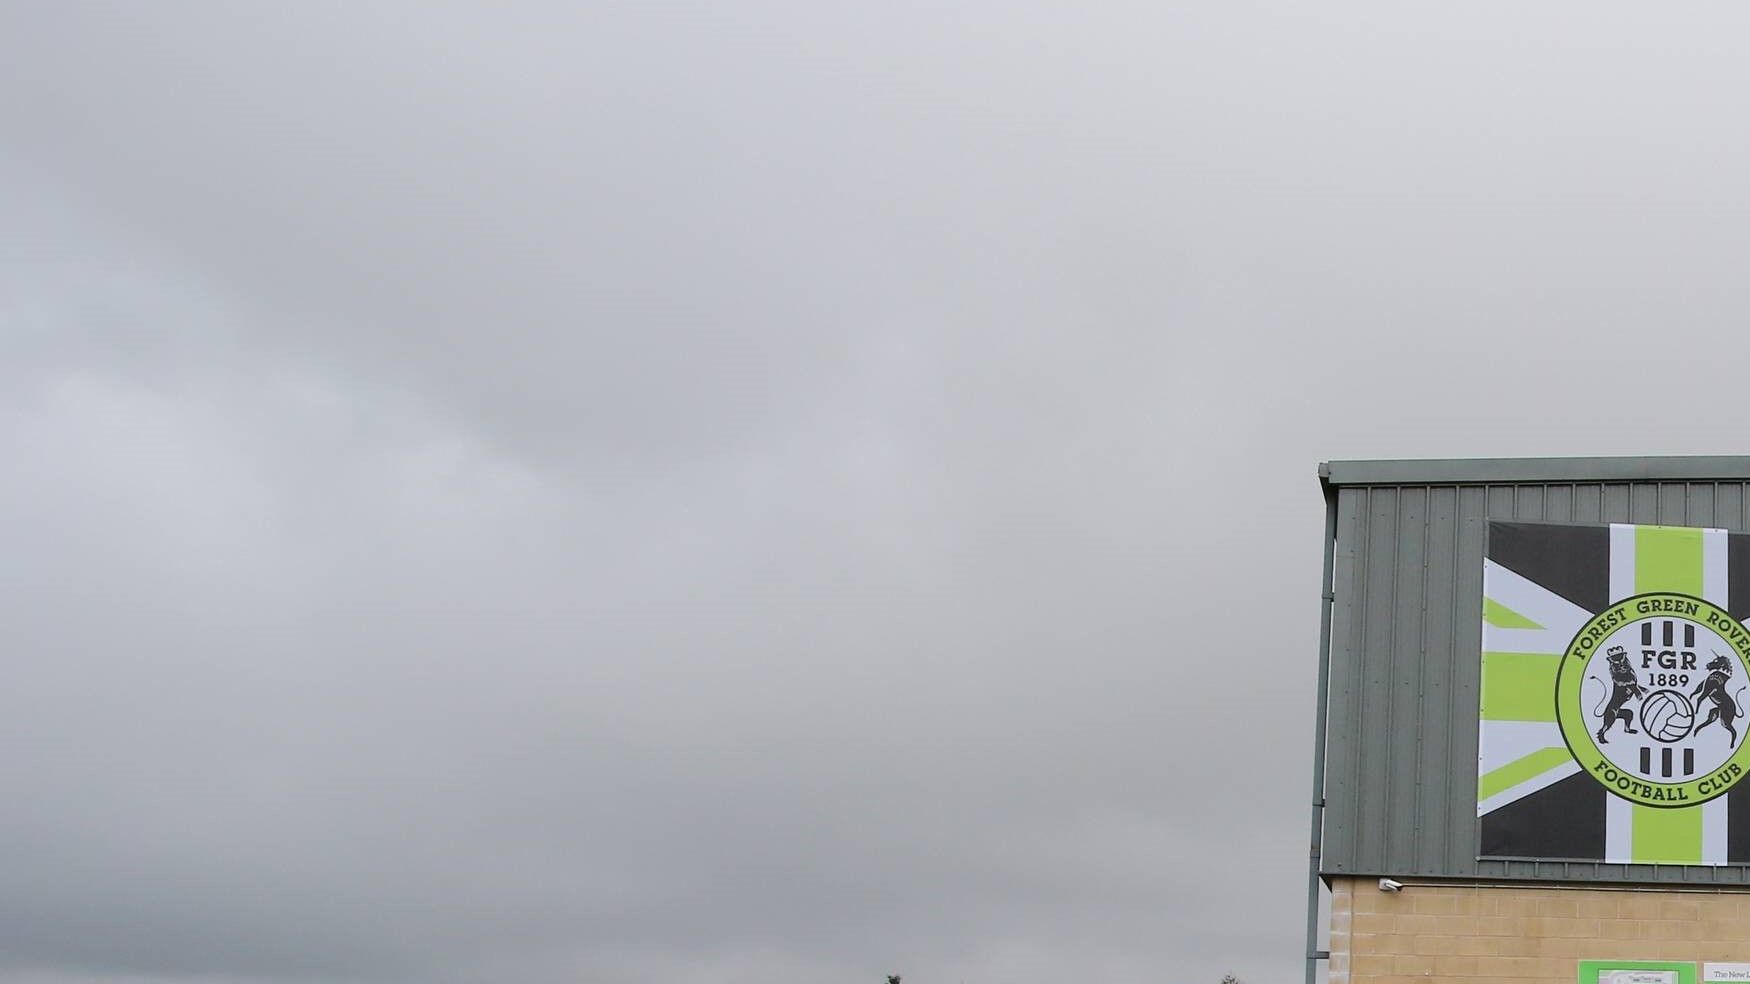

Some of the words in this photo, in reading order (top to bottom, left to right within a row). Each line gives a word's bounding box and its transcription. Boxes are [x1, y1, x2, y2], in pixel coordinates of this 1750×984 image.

[1573, 608, 1628, 660] FOREST
[1637, 599, 1700, 617] GREEN
[1641, 650, 1698, 671] FGR
[1649, 673, 1690, 687] 1889
[1593, 760, 1689, 801] FOOTBALL
[1698, 762, 1743, 795] CLUB
